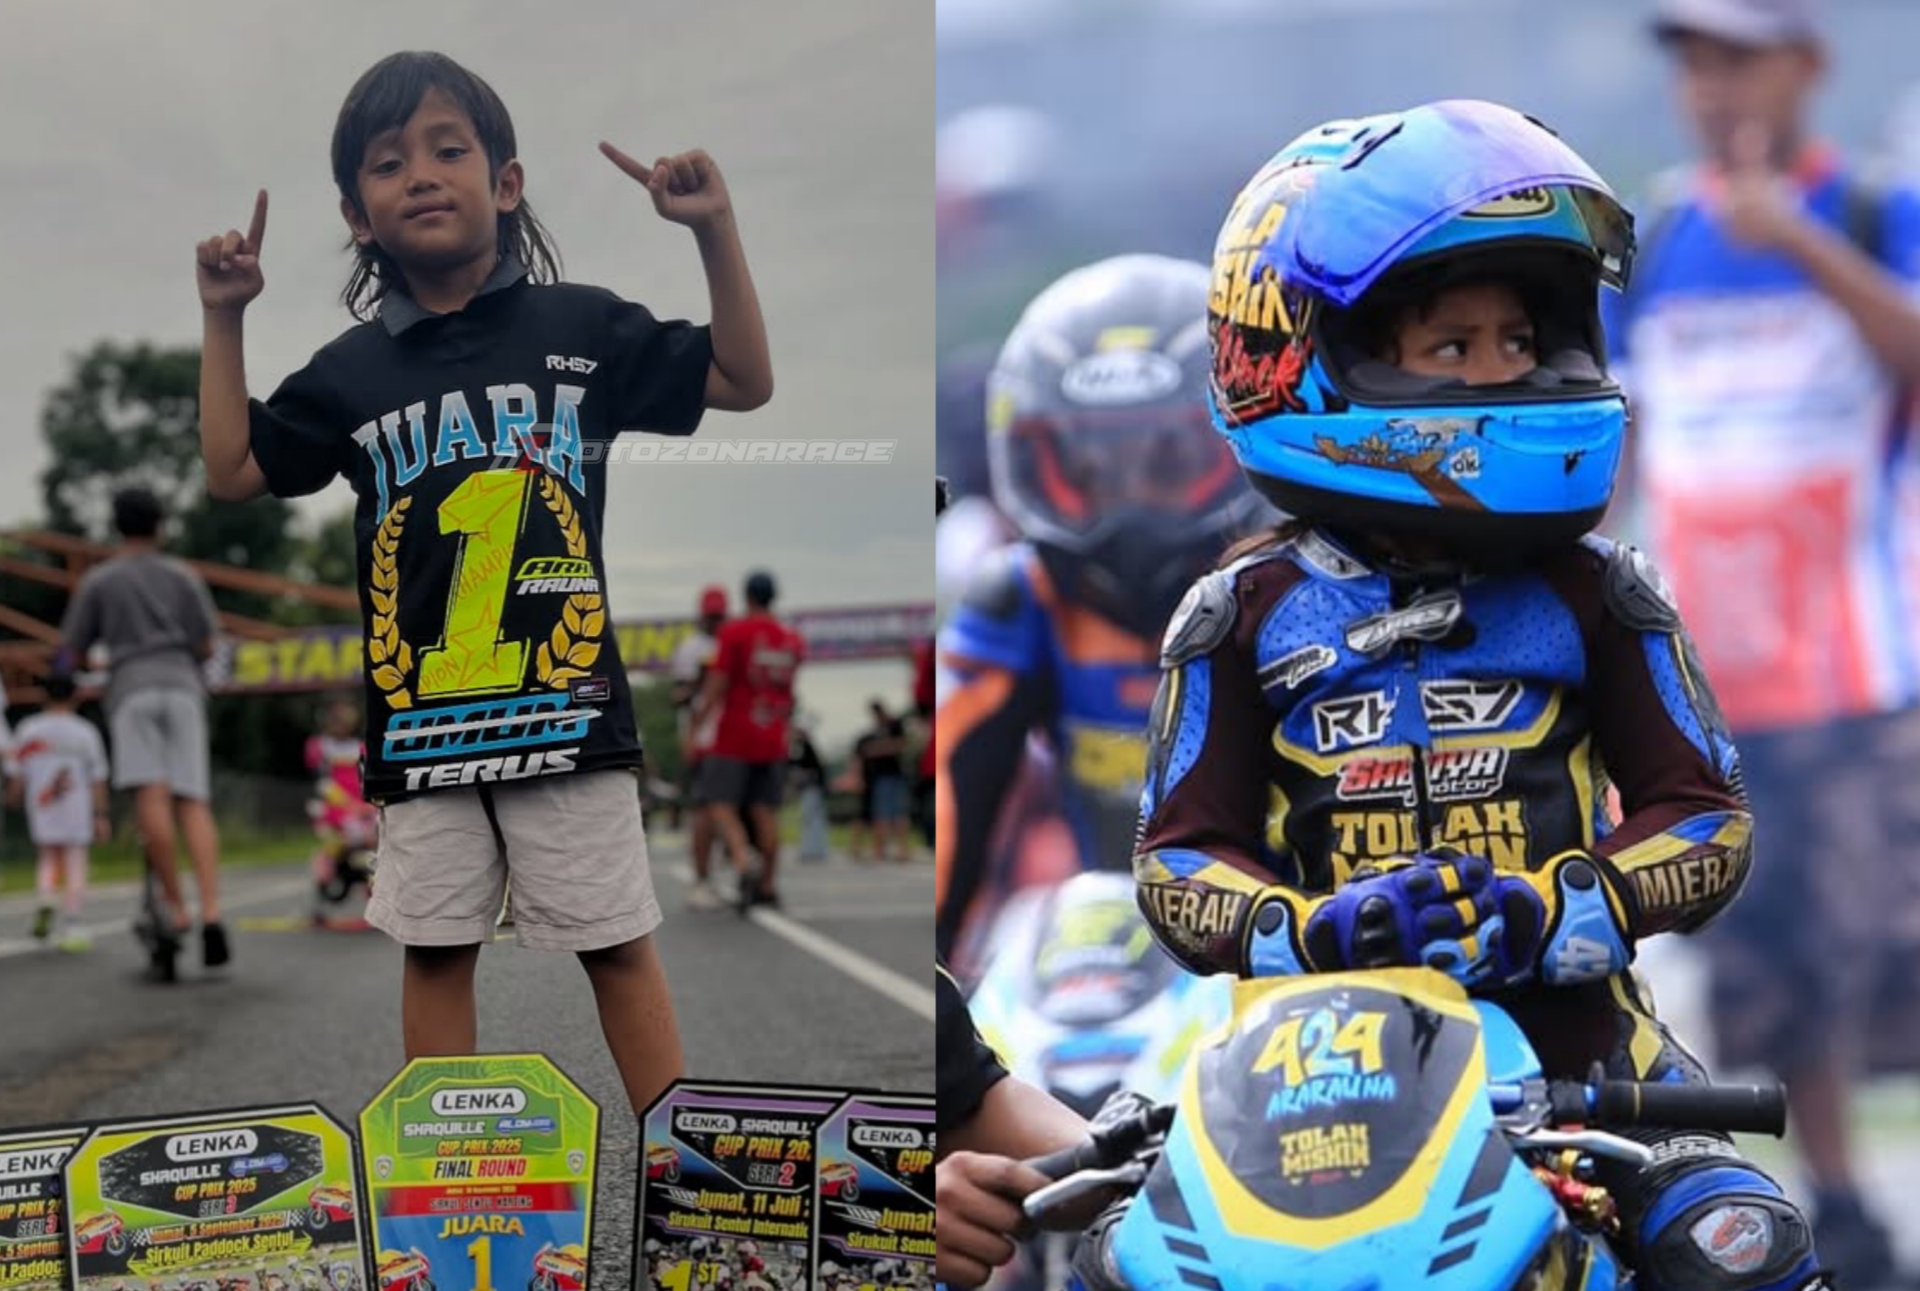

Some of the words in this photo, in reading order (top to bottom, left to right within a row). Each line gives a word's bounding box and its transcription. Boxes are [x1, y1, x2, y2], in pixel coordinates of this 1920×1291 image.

[351, 383, 587, 525] JUARA
[417, 467, 537, 698] 1
[404, 747, 580, 791] TERUS
[1252, 1007, 1389, 1088] 424
[441, 1093, 515, 1110] LENKA
[682, 1116, 729, 1130] LENKA
[740, 1118, 815, 1136] SHAQUILL
[859, 1129, 915, 1145] LENKA
[176, 1135, 247, 1156] LENKA
[436, 1140, 461, 1156] CUP
[490, 1138, 522, 1154] 2025
[713, 1134, 745, 1157] CUP
[746, 1137, 784, 1159] PRIX
[433, 1159, 474, 1179] FINAL
[477, 1157, 527, 1178] ROUND
[897, 1149, 933, 1173] CUP
[778, 1162, 796, 1186] 2
[174, 1184, 198, 1202] CUP
[199, 1180, 225, 1198] PRIX
[226, 1177, 258, 1195] 2025
[18, 1201, 46, 1218] PRIX
[225, 1195, 238, 1215] 3
[769, 1194, 802, 1217] Juli
[45, 1213, 58, 1234] 3
[199, 1217, 255, 1236] September
[437, 1214, 525, 1239] JUARA
[194, 1232, 251, 1258] Paddock
[253, 1229, 295, 1250] Sentul
[467, 1236, 497, 1291] 1
